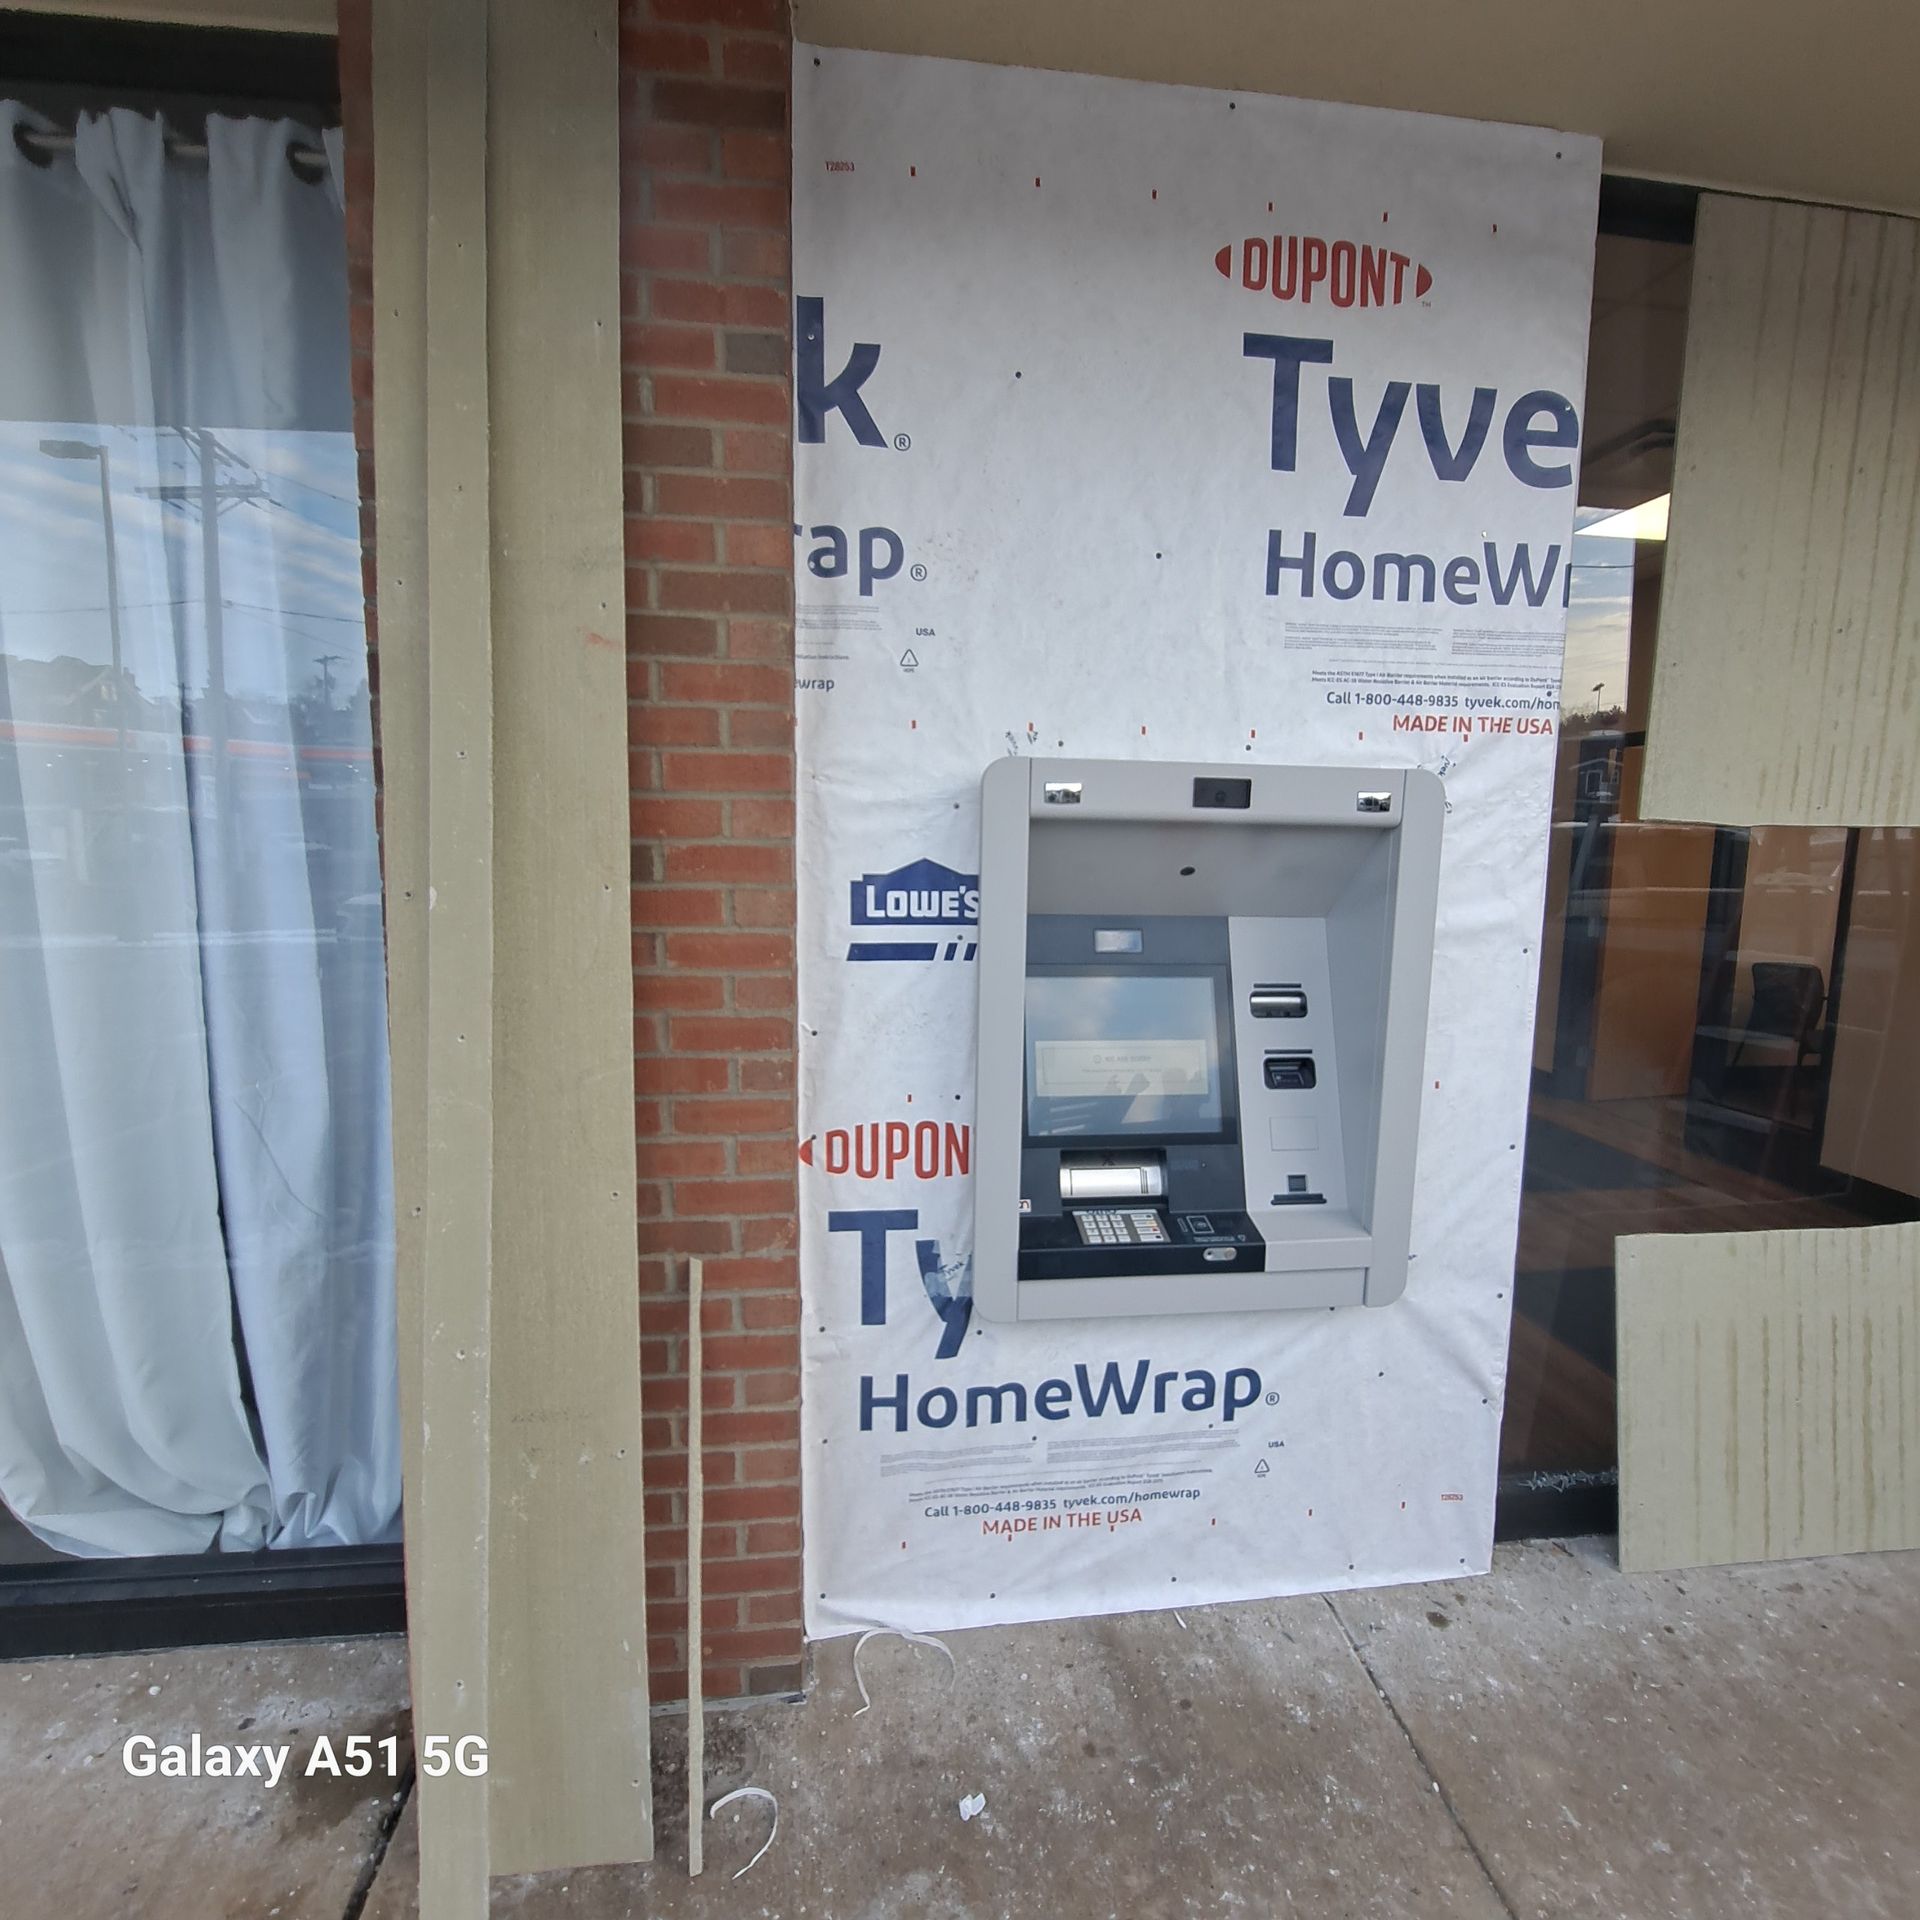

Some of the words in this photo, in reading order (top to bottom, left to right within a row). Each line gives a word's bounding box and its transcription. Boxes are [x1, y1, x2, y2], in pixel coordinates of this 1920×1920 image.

[1243, 235, 1410, 307] DUPONT
[1243, 332, 1579, 517] Tyve
[915, 628, 936, 637] USA
[1326, 691, 1351, 705] Call
[1355, 693, 1458, 707] 1-800-448-9835
[1393, 715, 1448, 732] MADE
[1452, 716, 1472, 733] IN
[1478, 717, 1513, 734] THE
[1517, 718, 1553, 735] USA
[825, 1120, 970, 1180] DUPON
[860, 1360, 1261, 1431] HomeWrap
[1268, 1440, 1285, 1448] USA
[925, 1506, 949, 1517] Call
[952, 1499, 1056, 1516] 1-800-448-9835
[1064, 1488, 1201, 1509] tyvek.com/homewrap
[982, 1517, 1038, 1536] MADE
[1043, 1515, 1061, 1531] IN
[1067, 1511, 1101, 1528] THE
[1107, 1508, 1142, 1524] USA
